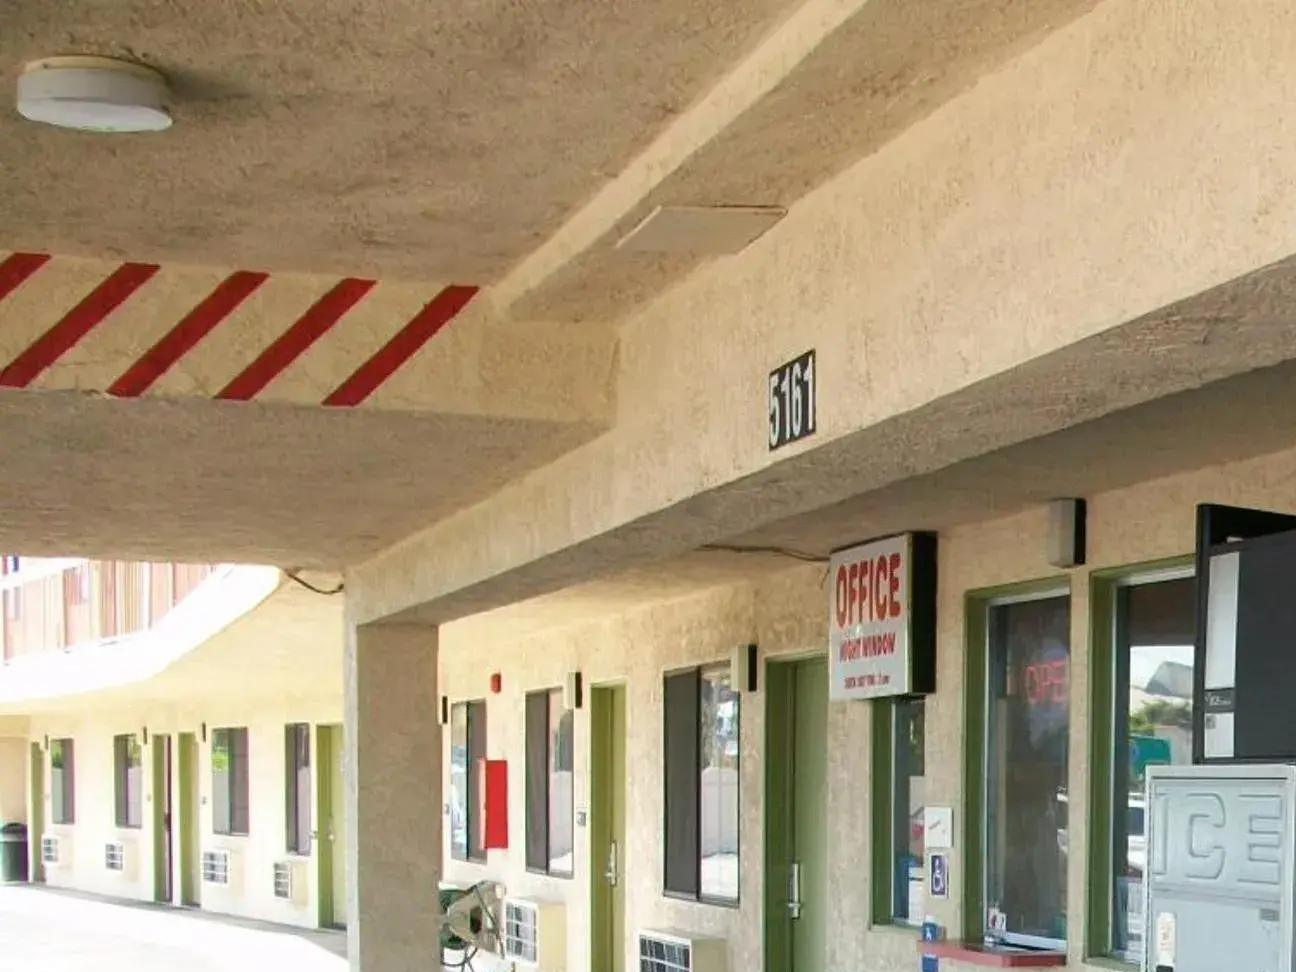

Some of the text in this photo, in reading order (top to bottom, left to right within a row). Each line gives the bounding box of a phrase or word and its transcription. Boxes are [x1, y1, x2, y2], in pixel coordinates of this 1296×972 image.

[770, 355, 813, 446] 5161
[836, 552, 902, 629] OFFICE
[862, 632, 896, 657] WINDOW
[1023, 660, 1069, 704] OPE
[1151, 791, 1283, 886] ICE
